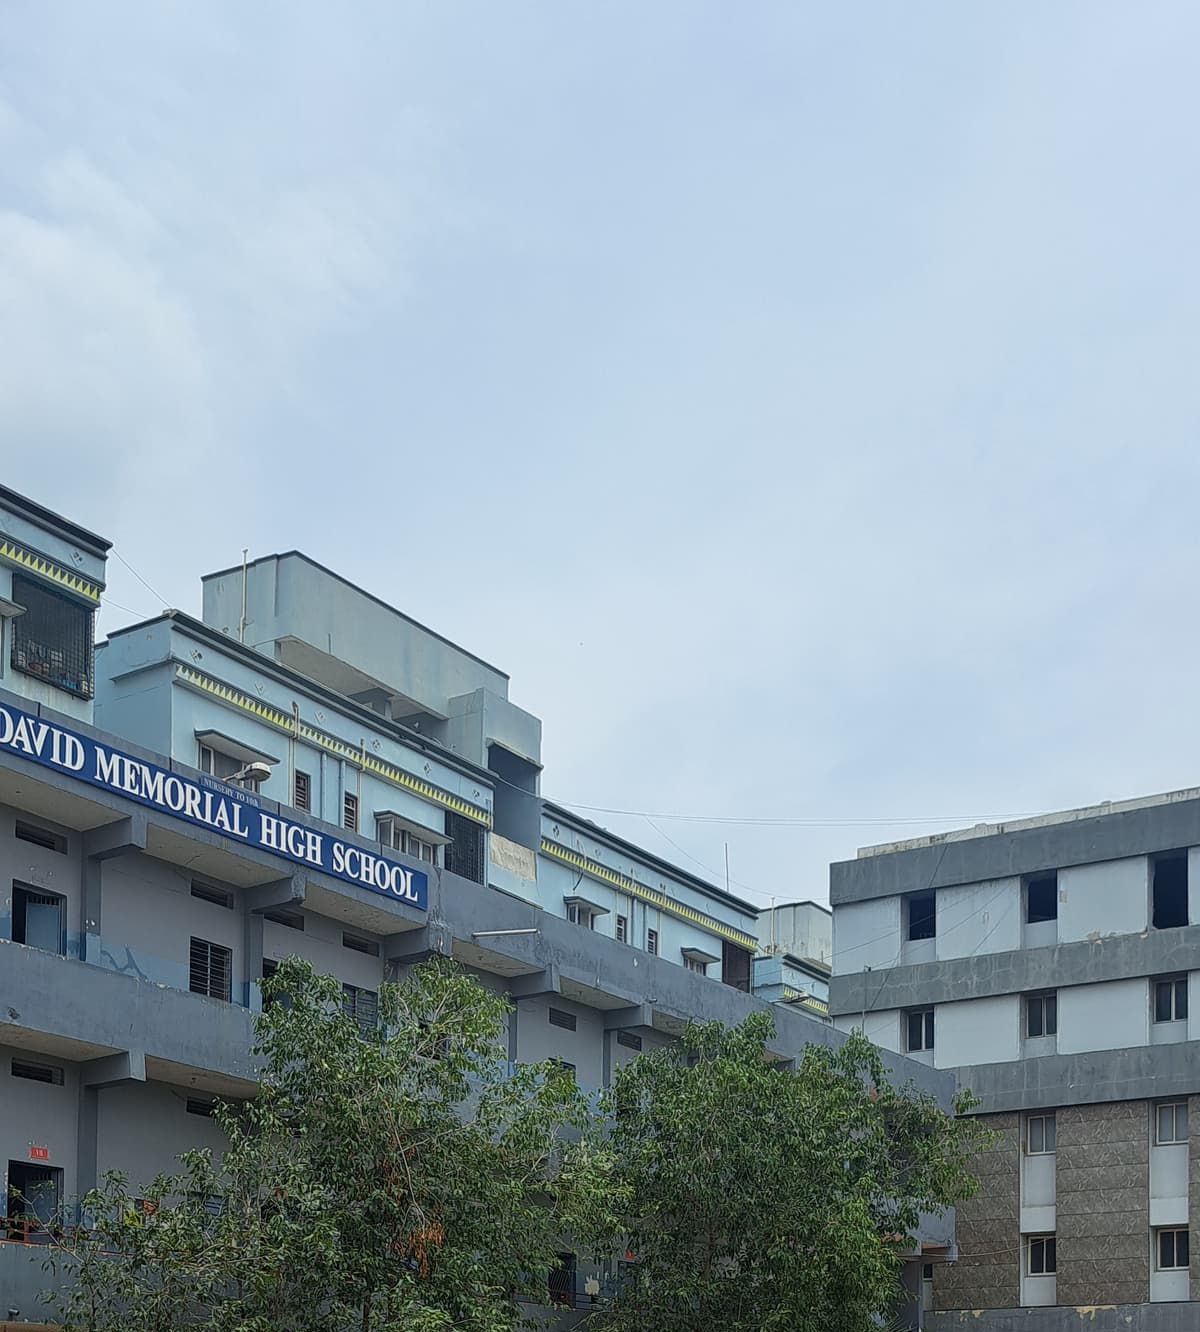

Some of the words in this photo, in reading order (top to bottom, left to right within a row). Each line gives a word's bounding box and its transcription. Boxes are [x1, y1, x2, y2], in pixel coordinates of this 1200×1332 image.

[94, 745, 249, 838] MEMORIAL
[259, 812, 324, 866] HIGH
[332, 842, 418, 902] SCHOOL
[203, 777, 235, 798] NURSERY
[235, 790, 245, 801] TO
